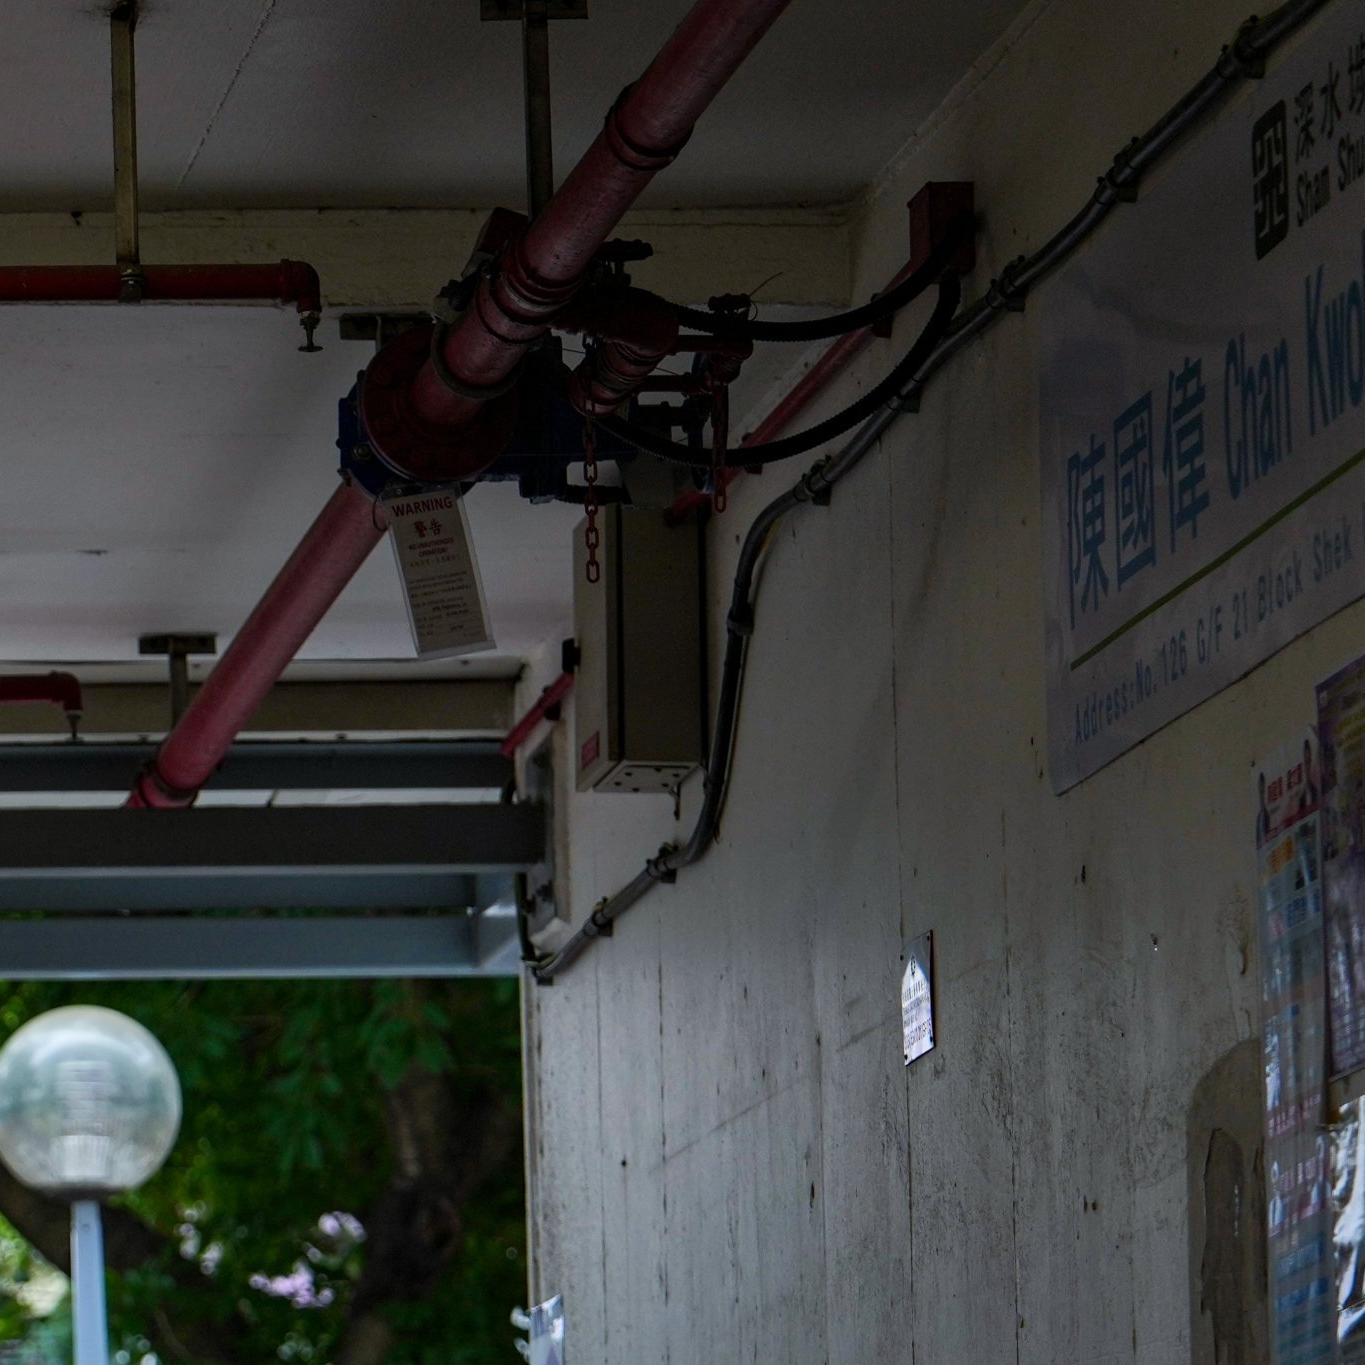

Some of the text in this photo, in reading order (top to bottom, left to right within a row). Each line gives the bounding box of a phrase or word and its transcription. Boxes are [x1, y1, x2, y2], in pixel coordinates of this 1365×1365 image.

[1297, 165, 1331, 227] Sham
[1224, 331, 1292, 500] Chan
[392, 496, 453, 517] WARNING
[413, 519, 442, 538] 警告
[1068, 357, 1210, 631] 陳國偉
[1197, 604, 1222, 664] G/F
[1232, 589, 1248, 640] 21
[1258, 549, 1303, 623] Block
[1313, 515, 1352, 583] Shek
